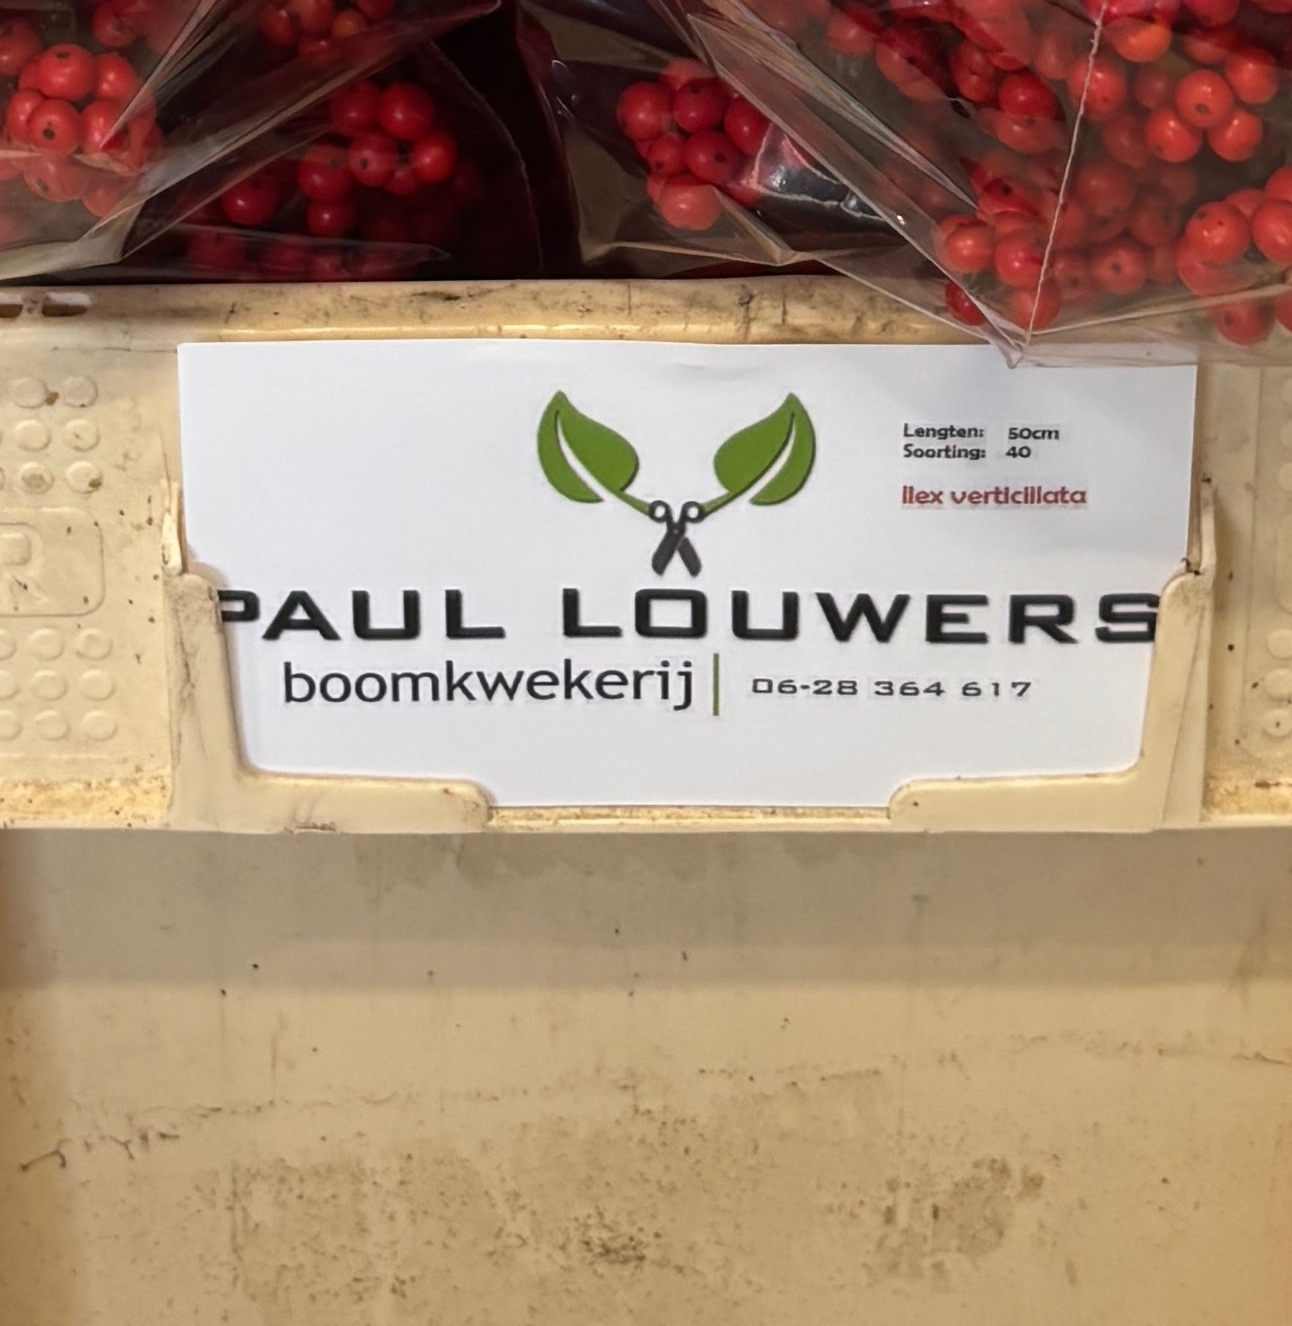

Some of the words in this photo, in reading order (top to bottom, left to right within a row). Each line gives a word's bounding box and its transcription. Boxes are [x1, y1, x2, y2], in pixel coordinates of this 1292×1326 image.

[1007, 427, 1060, 441] 50cm
[903, 443, 987, 461] Soorting:
[1005, 445, 1032, 459] 40
[902, 485, 944, 505] Ilex
[950, 485, 1087, 505] verticillata
[217, 589, 506, 641] PAUL
[562, 588, 1160, 645] LOUWERS
[284, 658, 693, 711] boomkwekerij
[752, 678, 858, 696] 06-28
[874, 680, 945, 697] 364
[961, 681, 1032, 697] 617
